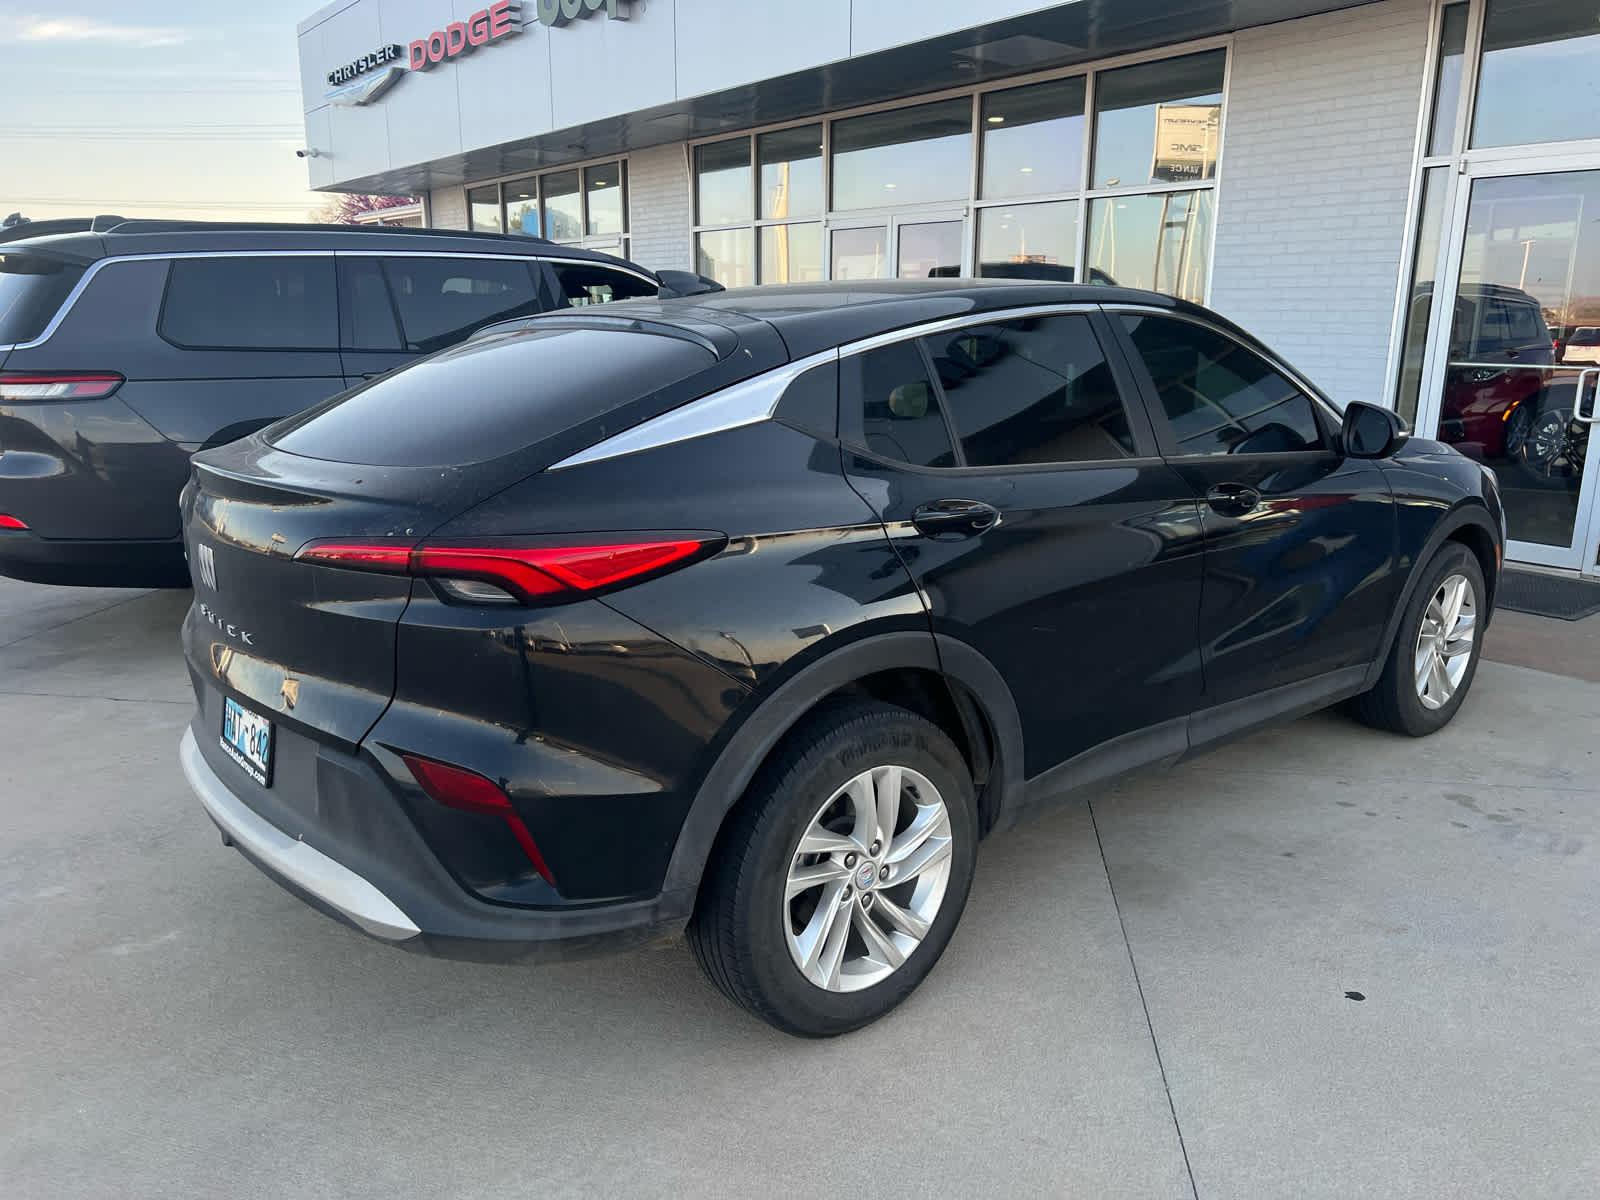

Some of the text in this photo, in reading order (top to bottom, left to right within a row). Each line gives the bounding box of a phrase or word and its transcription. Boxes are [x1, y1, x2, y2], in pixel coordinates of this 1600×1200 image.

[409, 0, 514, 71] DODGE
[327, 44, 397, 86] CHRYSLER
[200, 602, 253, 645] BUICK
